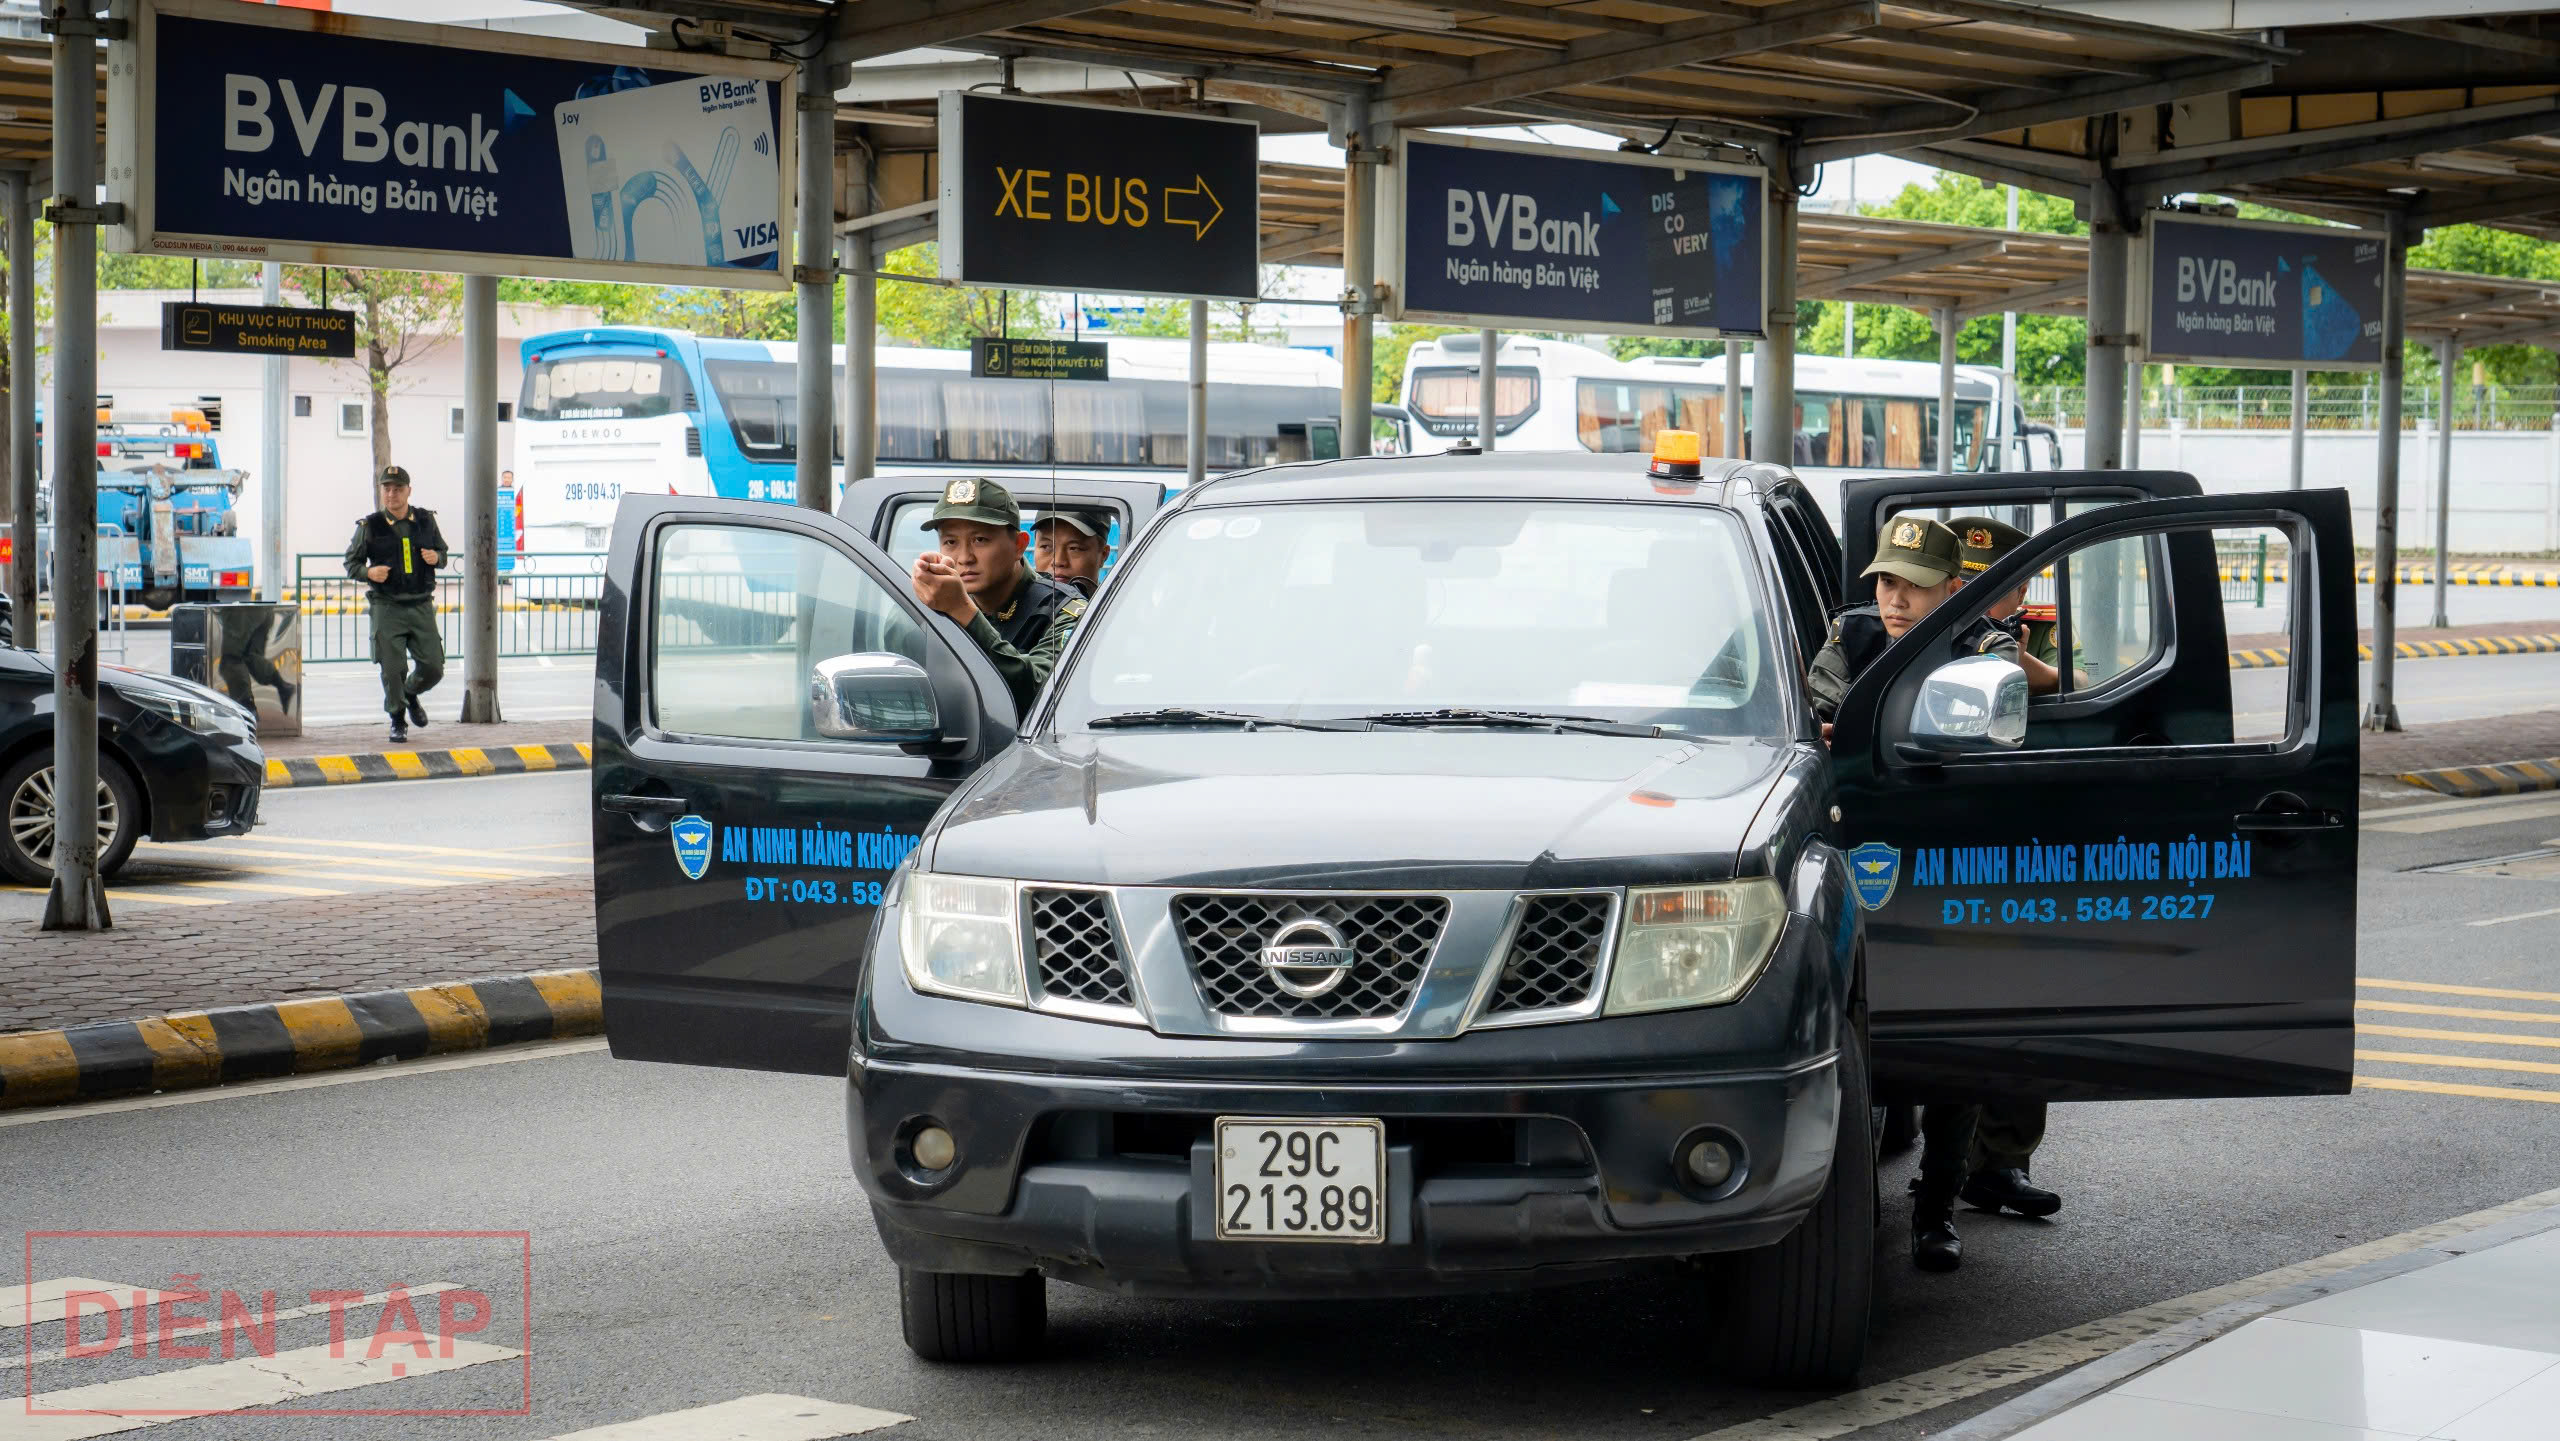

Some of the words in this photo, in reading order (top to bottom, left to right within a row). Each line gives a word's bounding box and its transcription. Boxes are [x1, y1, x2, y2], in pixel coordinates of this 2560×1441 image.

[700, 81, 756, 103] BVBank
[225, 73, 499, 173] BVBank
[562, 113, 579, 126] Joy
[224, 167, 300, 205] Ngân
[308, 174, 377, 214] hàng
[386, 179, 437, 212] Bản
[445, 185, 498, 222] Việt
[995, 167, 1051, 222] XE
[1065, 173, 1149, 228] BUS
[1652, 192, 1674, 213] DIS
[1448, 188, 1600, 256] BVBank
[1664, 214, 1684, 234] CO
[154, 240, 187, 249] GOLDSUN
[189, 242, 213, 251] MEDIA
[733, 221, 778, 249] VISA
[1673, 232, 1708, 255] VERY
[1447, 258, 1489, 286] Ngân
[1493, 260, 1532, 289] hàng
[1536, 263, 1565, 287] Bản
[1569, 266, 1600, 294] Việt
[2178, 256, 2276, 307] BVBank
[218, 312, 244, 326] KHU
[248, 314, 274, 330] VỰC
[277, 312, 301, 328] HÚT
[2177, 312, 2204, 333] Ngân
[2206, 312, 2231, 334] hàng
[2234, 313, 2253, 332] Bản
[2256, 315, 2275, 336] Việt
[238, 332, 295, 350] Smoking
[298, 336, 326, 349] Area
[1012, 358, 1030, 366] CHO
[562, 428, 621, 438] DAEWOO
[748, 480, 764, 499] 29B
[184, 568, 208, 578] SMT
[722, 826, 747, 862] AN
[752, 828, 796, 864] NINH
[802, 822, 852, 868] HÀNG
[1912, 848, 1945, 885] AN
[1952, 846, 2008, 884] NINH
[2016, 837, 2077, 883] HÀNG
[2083, 835, 2160, 881] KHÔNG
[2168, 834, 2206, 887] NỘI
[2214, 833, 2250, 878] BÀI
[1942, 899, 1991, 924] ĐT:
[2141, 894, 2215, 920] 2627
[1270, 951, 1342, 963] NISSAN
[1258, 1131, 1340, 1177] 29C
[1227, 1184, 1373, 1231] 213.89
